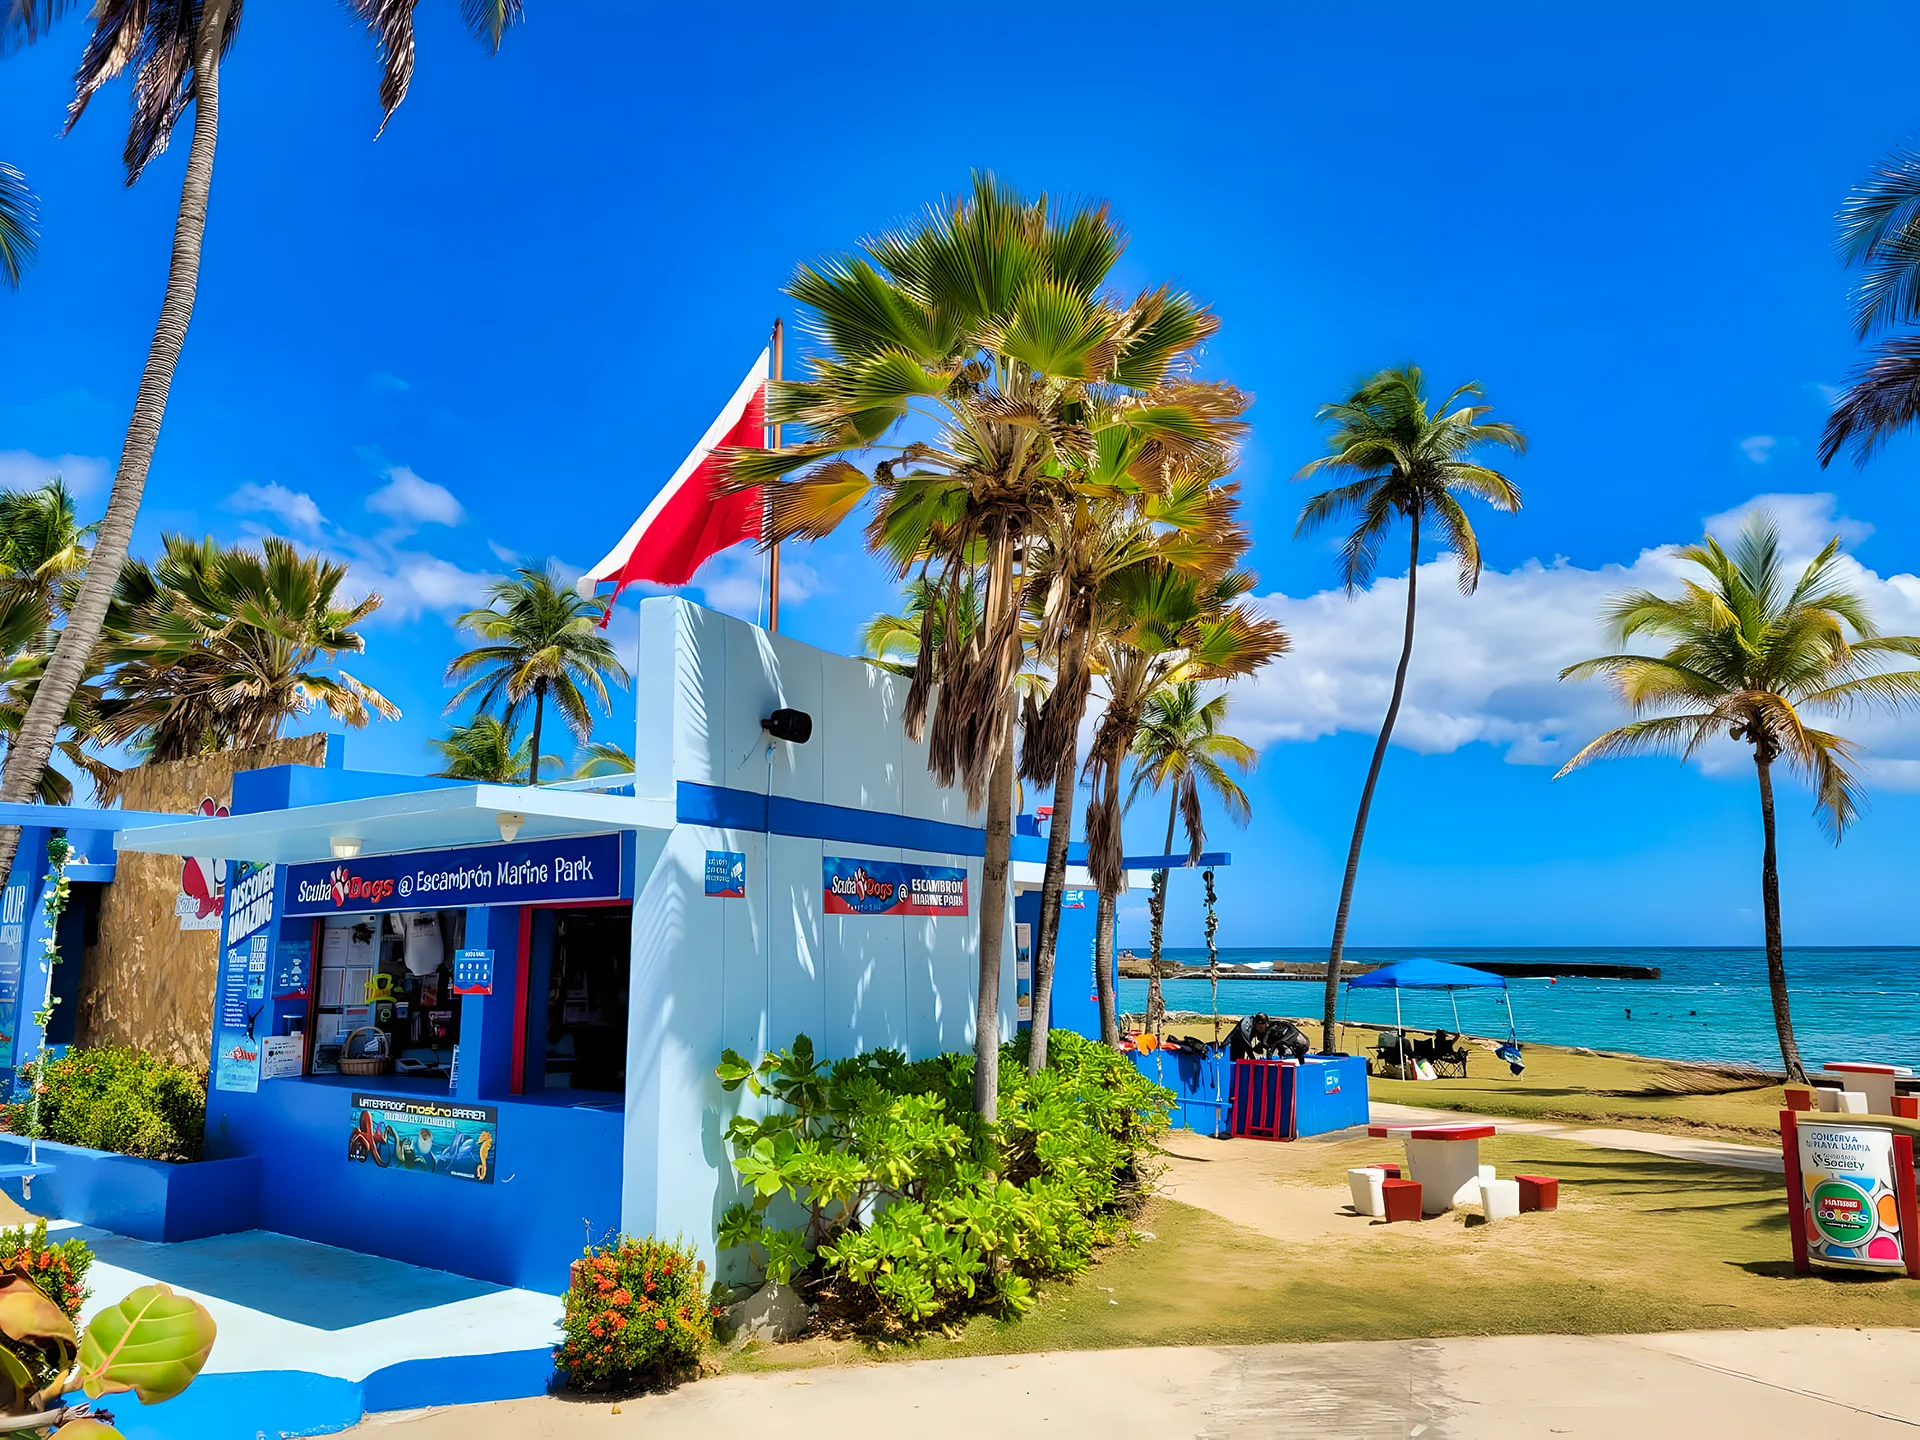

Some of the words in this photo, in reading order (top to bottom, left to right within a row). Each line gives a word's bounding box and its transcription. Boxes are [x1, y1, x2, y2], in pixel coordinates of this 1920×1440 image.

[297, 879, 332, 902] Scuba
[348, 876, 394, 903] Dogs
[398, 875, 414, 898] @
[416, 864, 492, 891] Escambrón
[497, 859, 548, 886] Marine
[554, 855, 594, 883] Park
[831, 875, 857, 895] Scuba
[867, 878, 893, 900] Dogs
[3, 885, 26, 924] OUR
[911, 893, 943, 906] MARINE
[943, 894, 964, 907] PARK
[227, 891, 274, 947] AMAZING
[1811, 1132, 1858, 1142] CONSERVA
[1824, 1158, 1865, 1171] Society
